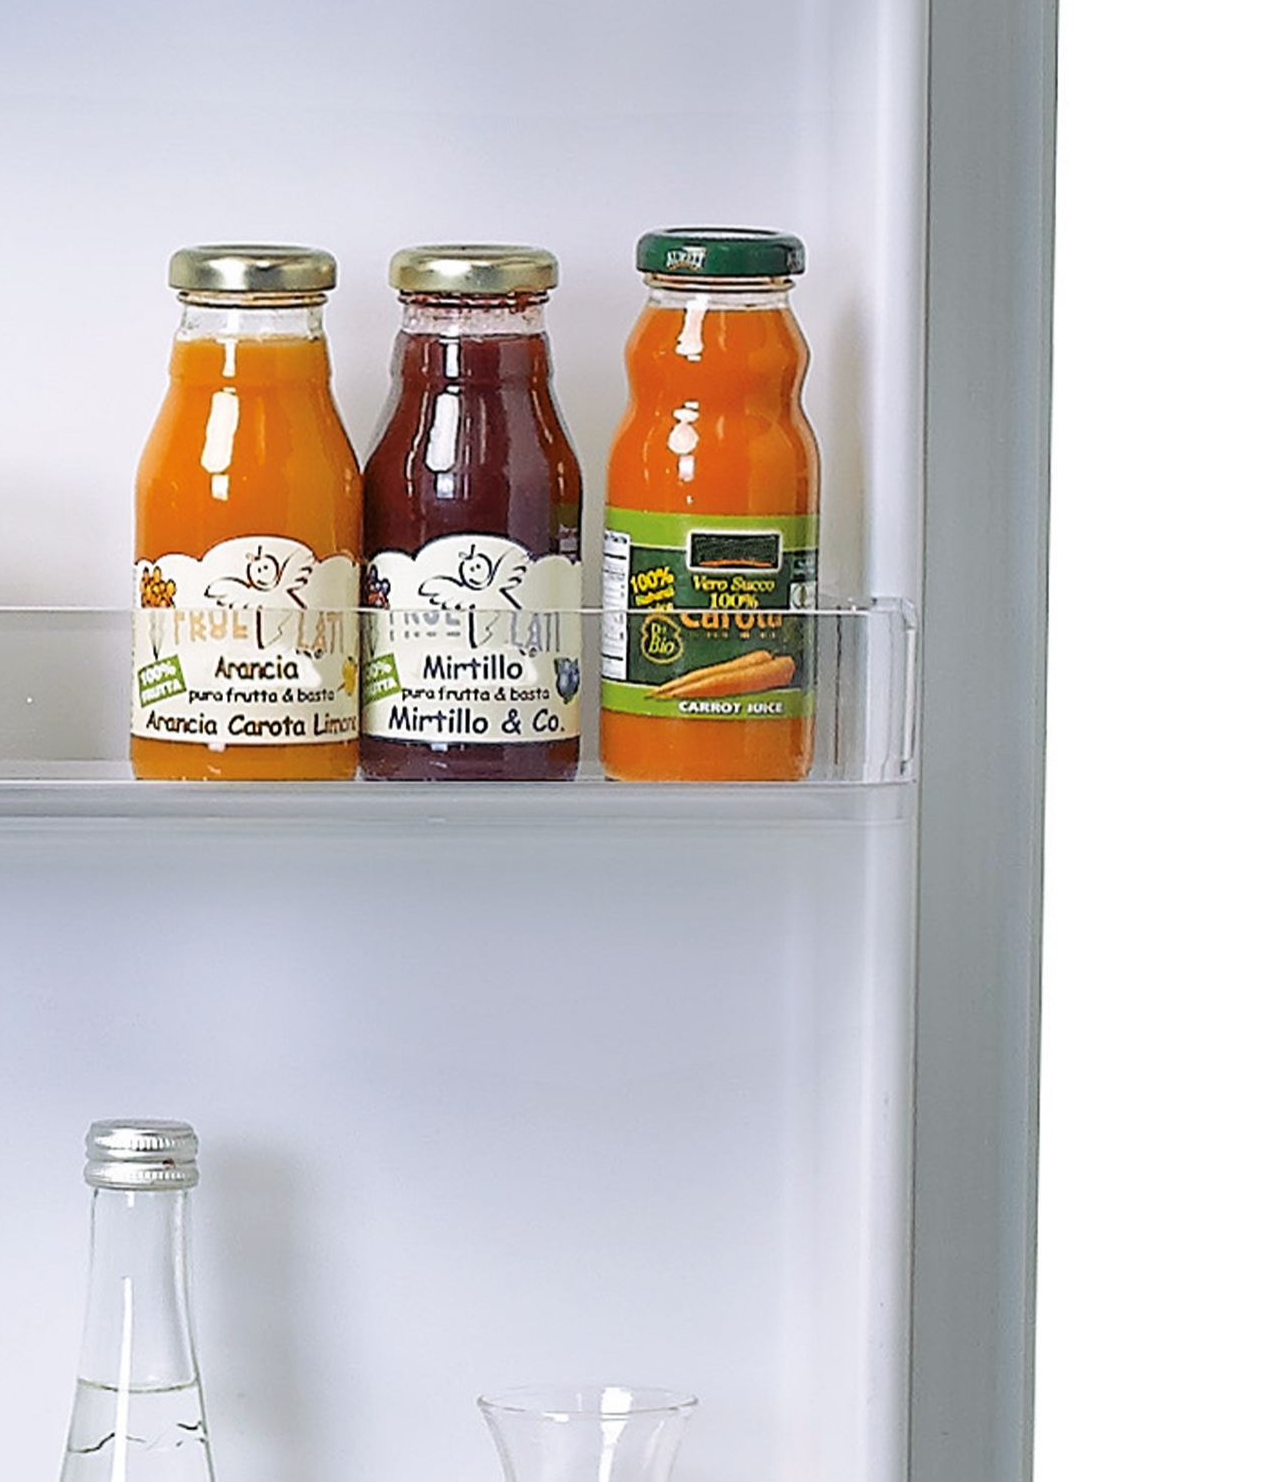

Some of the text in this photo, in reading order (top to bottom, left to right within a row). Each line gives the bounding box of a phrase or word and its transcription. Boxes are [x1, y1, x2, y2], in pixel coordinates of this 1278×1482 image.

[629, 566, 675, 594] 100%
[693, 574, 776, 594] Vero Succo
[709, 591, 760, 610] 100%
[214, 654, 300, 680] Arancia
[423, 653, 523, 680] Mirtillo
[188, 687, 336, 704] pura frutta & basta
[401, 686, 551, 702] pura frutta & basta
[677, 700, 742, 715] CARROT
[145, 709, 218, 736] Arancia
[227, 713, 307, 737] Carota
[388, 704, 565, 736] Mirtillo & Co.
